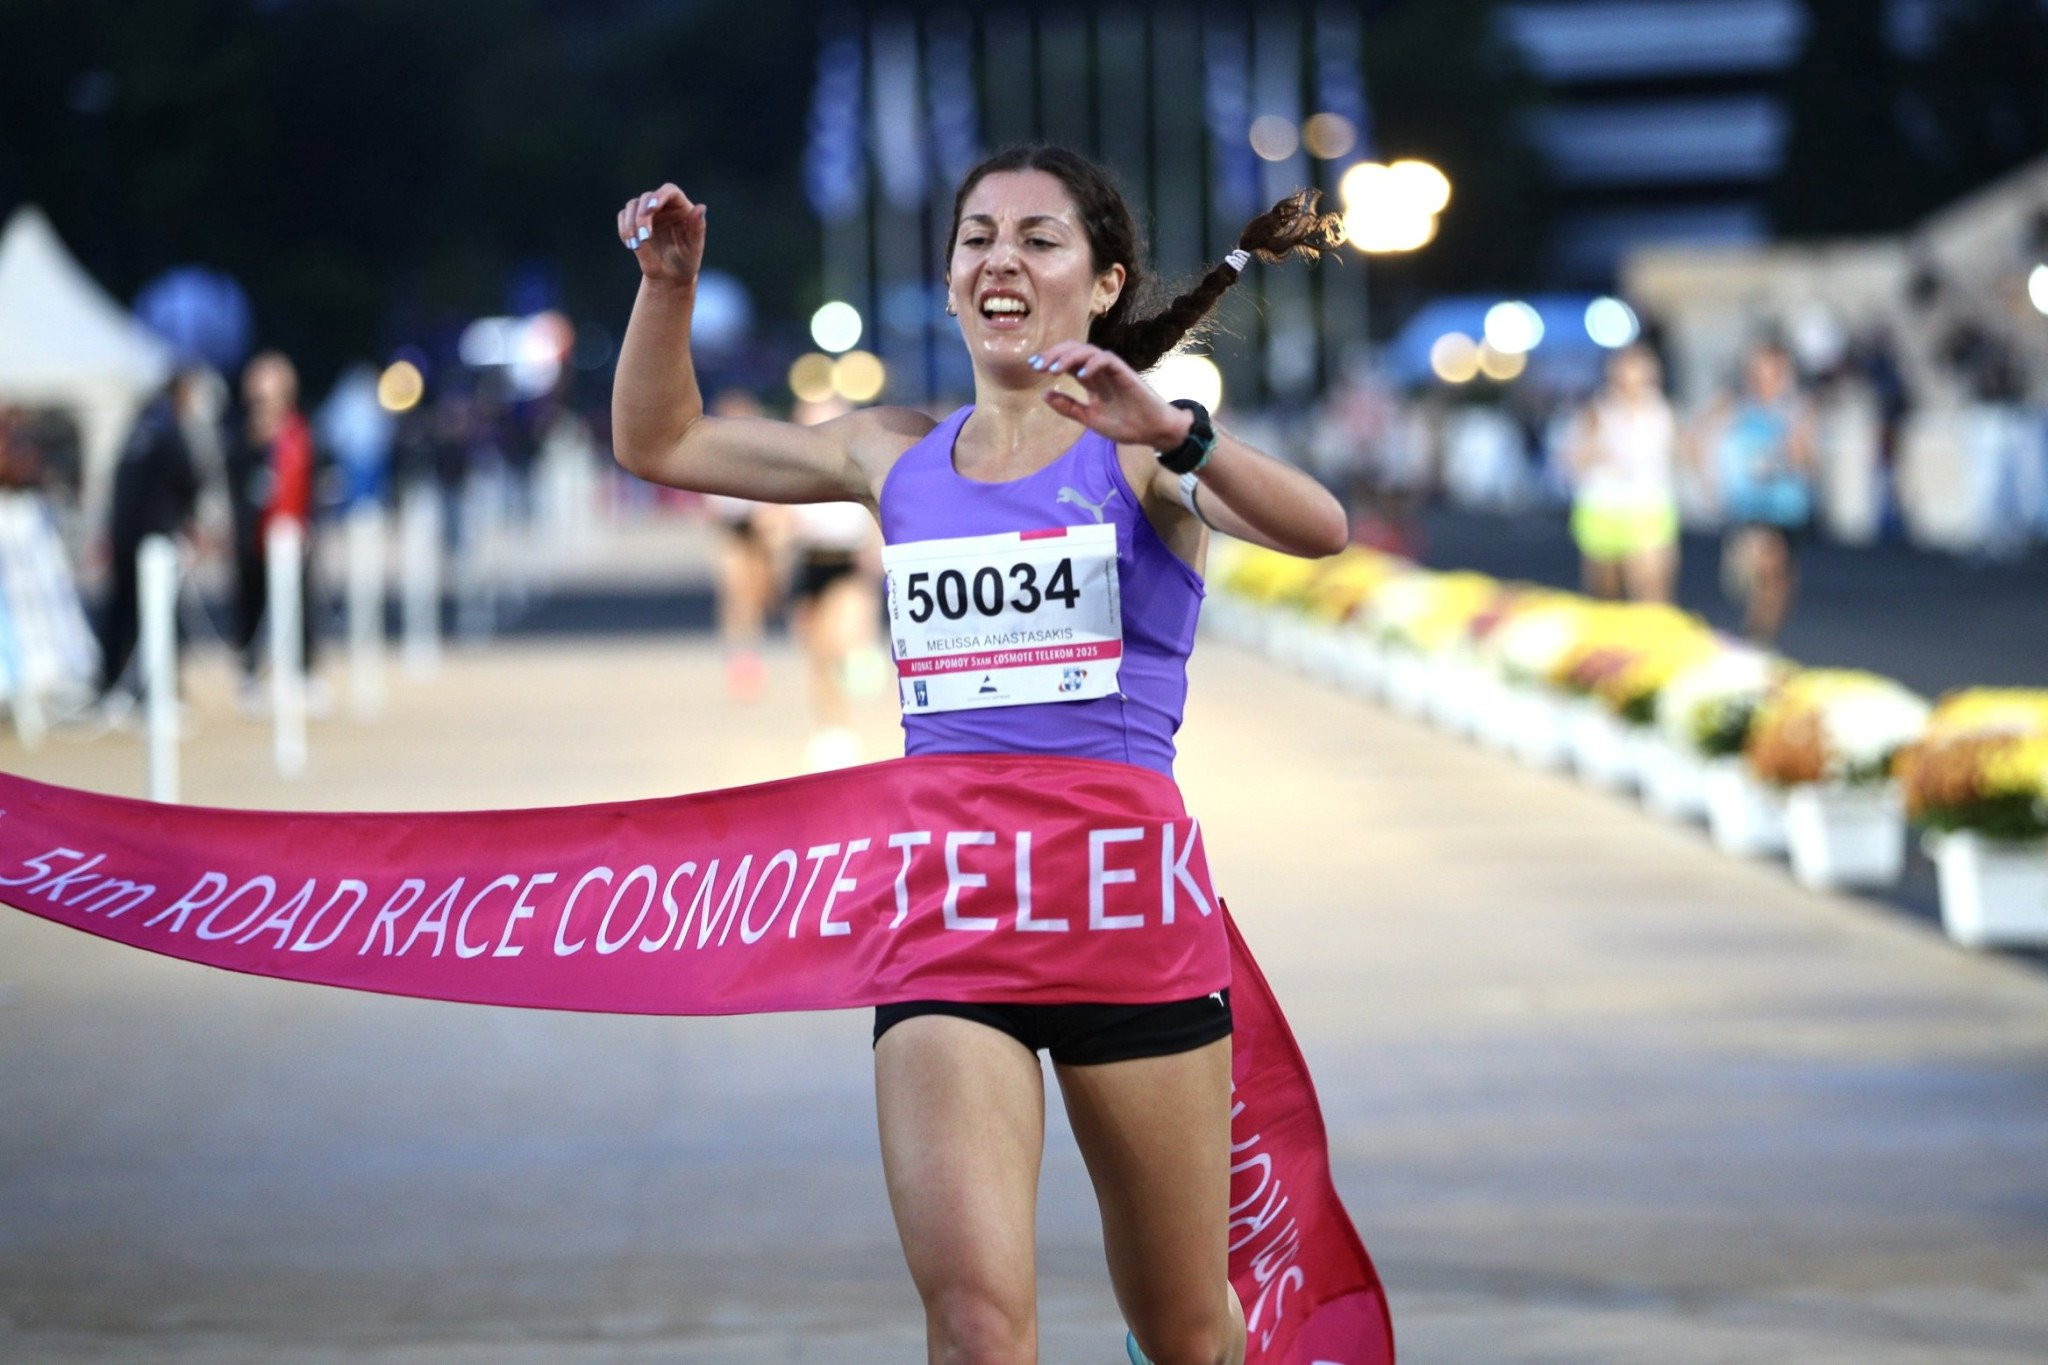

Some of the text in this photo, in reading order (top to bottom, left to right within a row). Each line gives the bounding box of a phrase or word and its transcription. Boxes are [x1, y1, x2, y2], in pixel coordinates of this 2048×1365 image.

[908, 558, 1080, 623] 50034
[926, 627, 1074, 651] MELISSA ANASTASAKIS
[993, 652, 1033, 666] COSMOTE
[1035, 648, 1074, 661] TELEKOM
[1076, 645, 1099, 658] 2025
[0, 817, 1220, 959] 5km ROAD RACE COSMOTE TELEK
